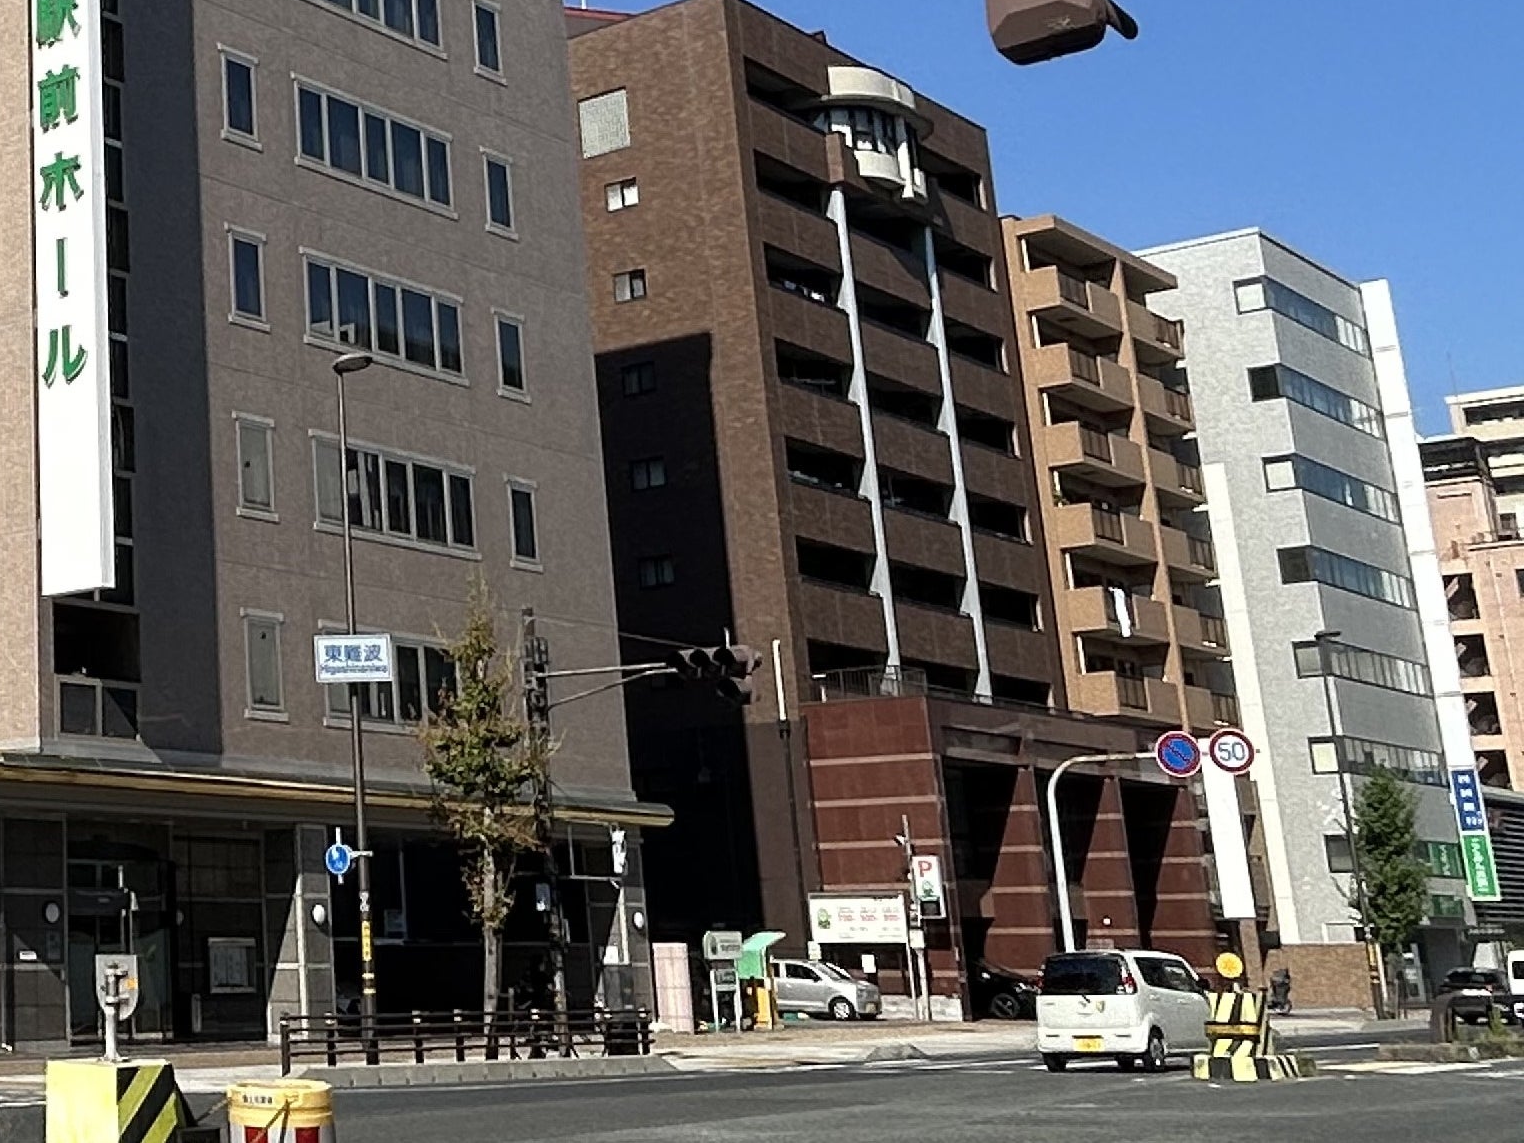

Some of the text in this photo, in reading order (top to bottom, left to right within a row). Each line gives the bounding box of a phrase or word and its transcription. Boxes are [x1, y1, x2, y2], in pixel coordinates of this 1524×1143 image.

[324, 645, 383, 662] 東難波
[1218, 742, 1246, 761] 50
[918, 860, 933, 878] P
